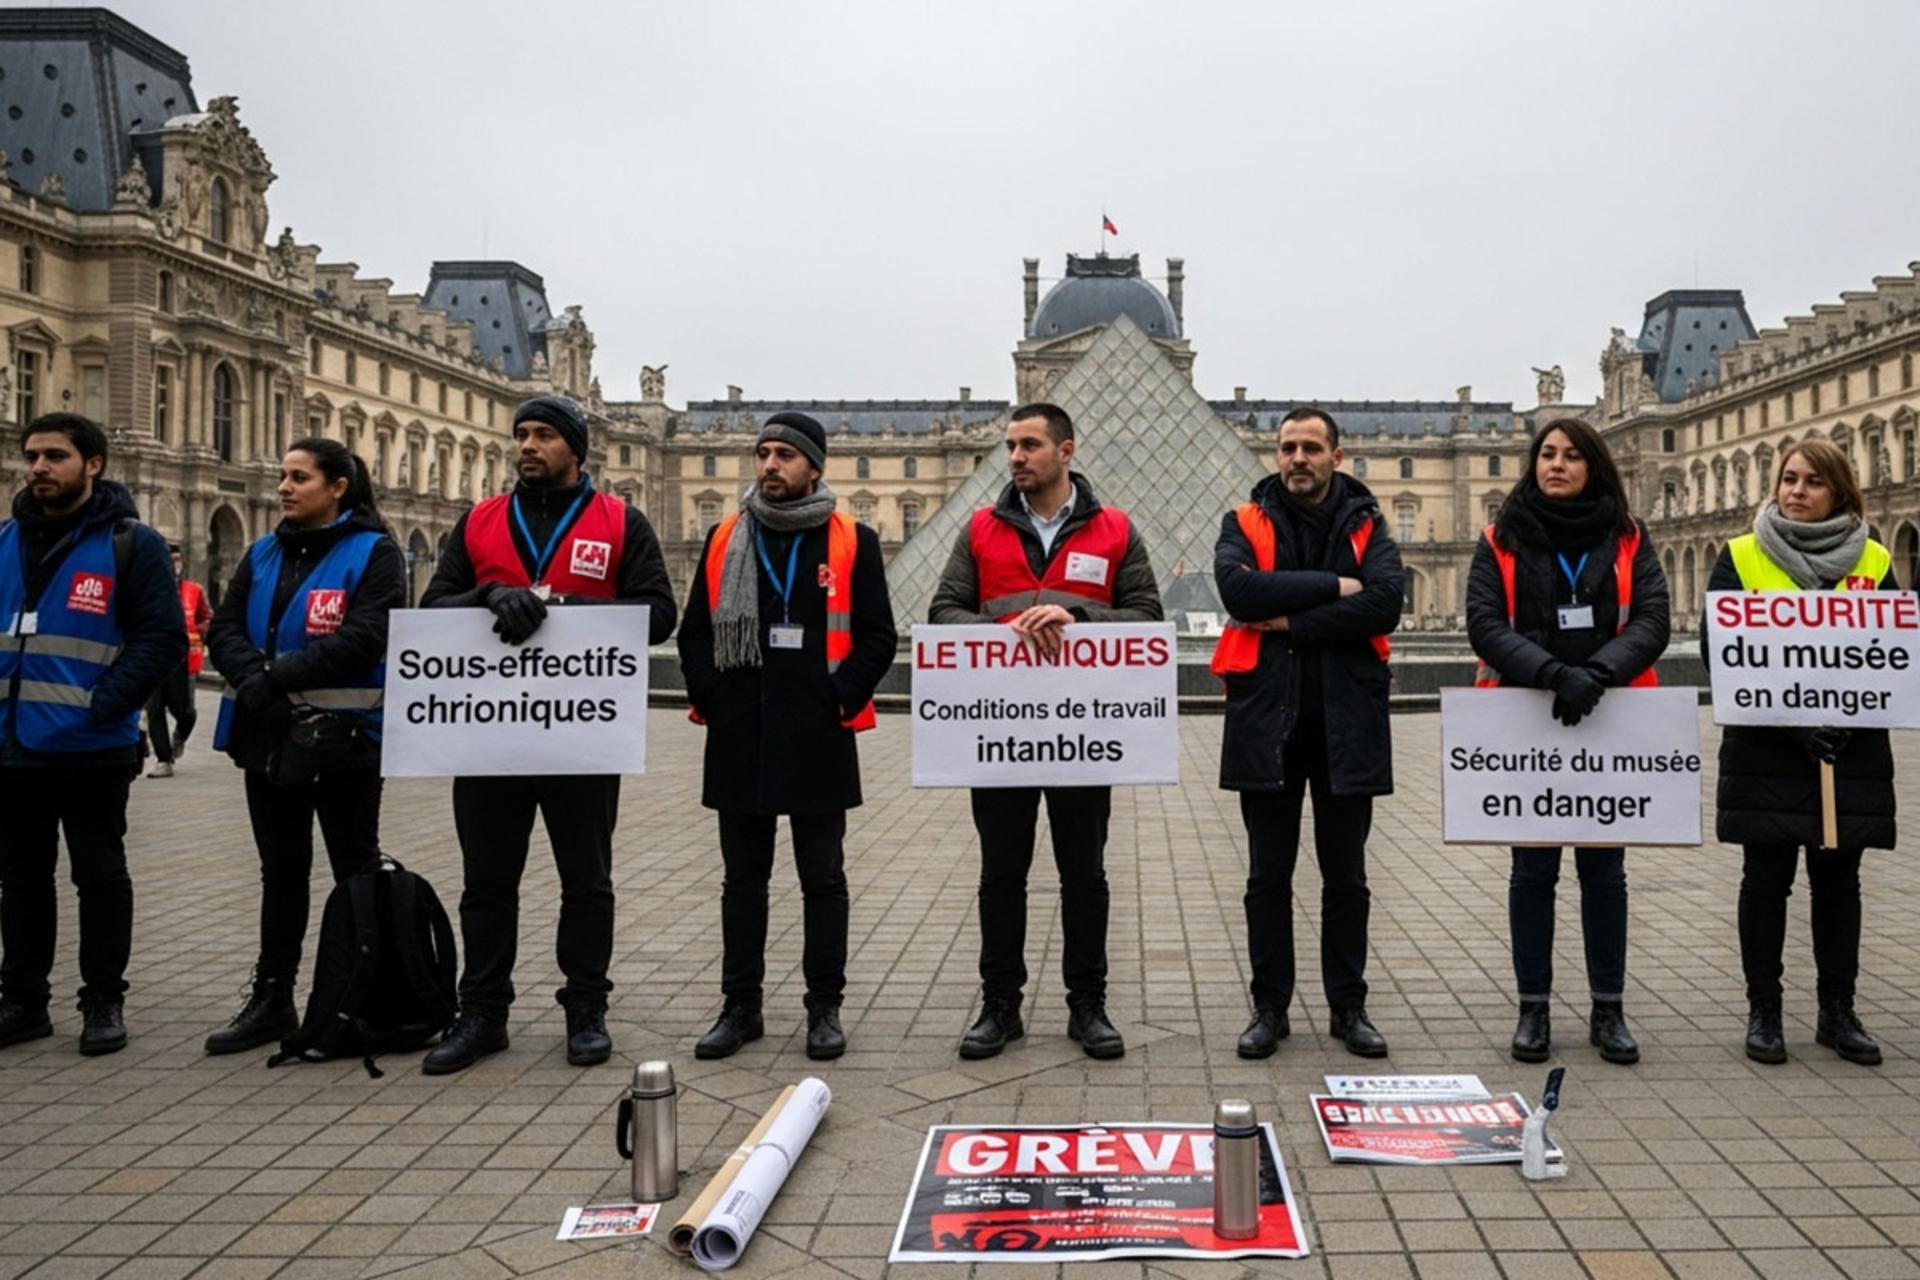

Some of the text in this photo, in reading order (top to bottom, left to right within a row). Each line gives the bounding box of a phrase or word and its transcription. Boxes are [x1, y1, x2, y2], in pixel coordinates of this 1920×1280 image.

[1715, 589, 1918, 630] SÉCURITÉ
[398, 647, 637, 680] Sous-effectifs
[917, 641, 957, 669] LE
[1721, 636, 1910, 671] du musée
[406, 692, 617, 730] chrioniques
[919, 697, 1166, 721] Conditions de travail
[1734, 683, 1892, 717] en danger
[977, 734, 1124, 763] intanbles
[1450, 747, 1701, 773] Sécurité du musée
[1482, 788, 1652, 826] en danger
